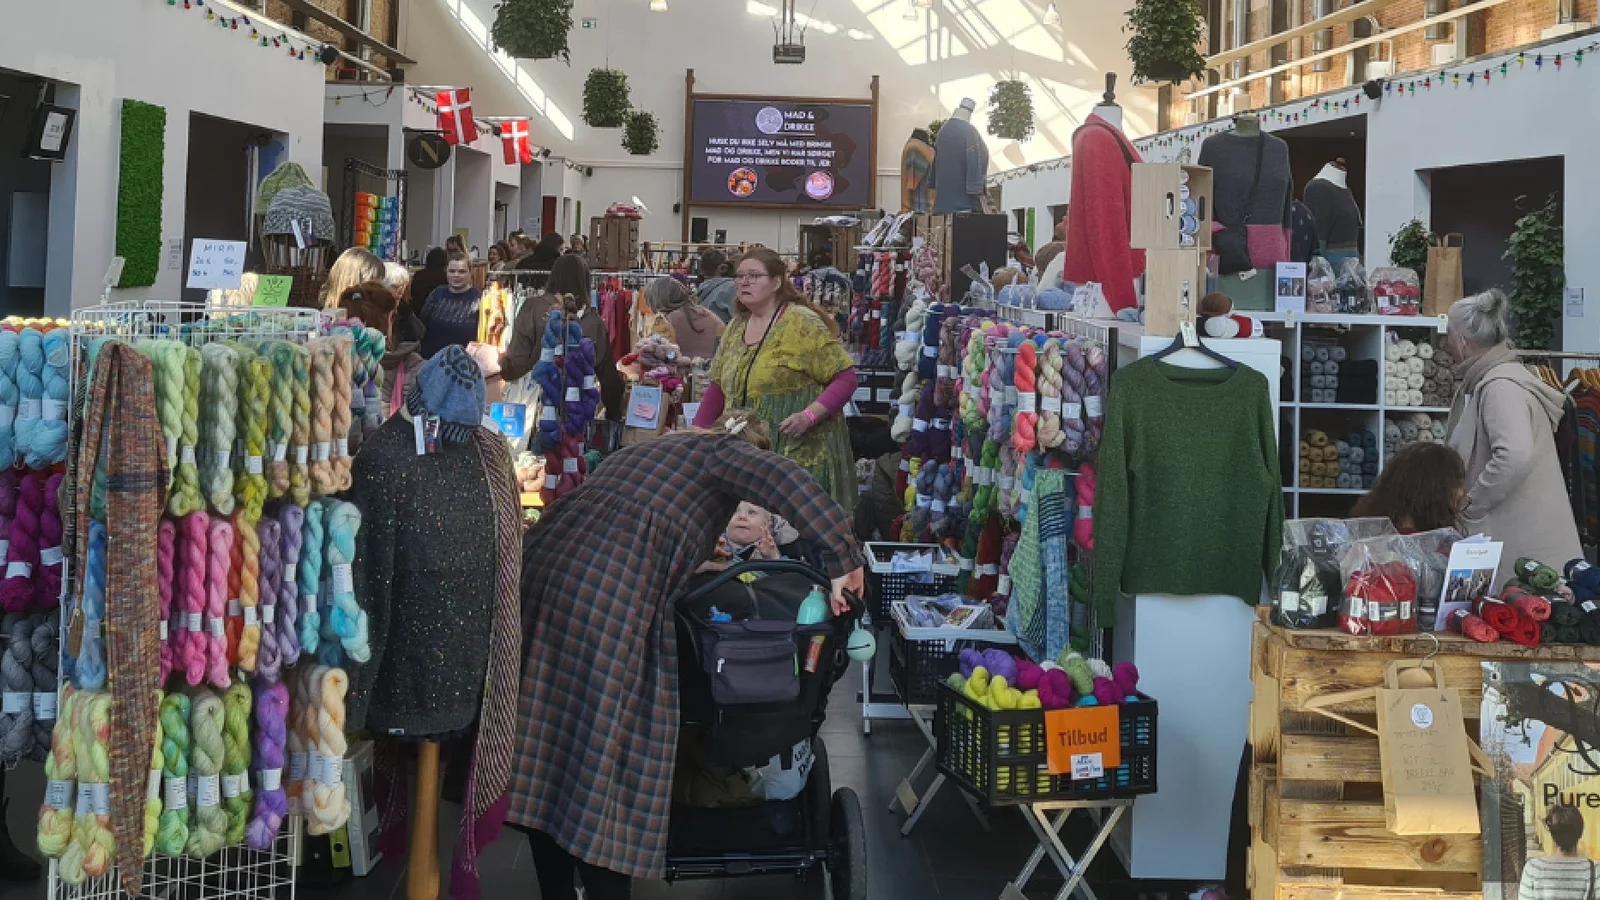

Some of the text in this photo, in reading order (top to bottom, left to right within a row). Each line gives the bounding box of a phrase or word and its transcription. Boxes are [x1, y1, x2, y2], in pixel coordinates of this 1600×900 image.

[784, 111, 815, 119] MAD &
[784, 122, 816, 131] DRIKKE
[418, 140, 440, 163] N
[724, 147, 736, 155] OG
[1058, 726, 1108, 747] Tilbud
[1543, 783, 1600, 808] Pure
